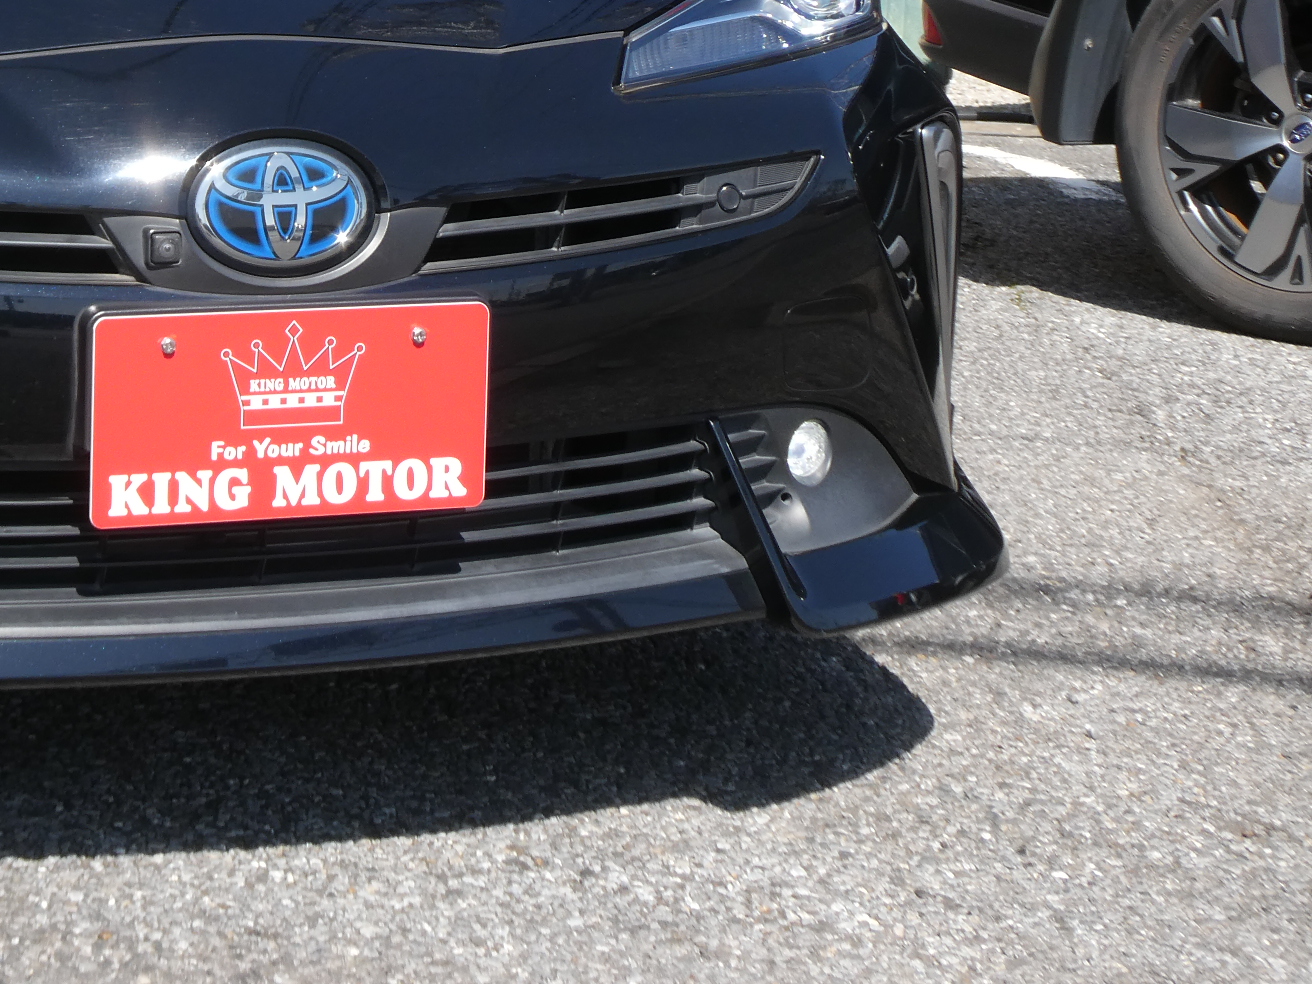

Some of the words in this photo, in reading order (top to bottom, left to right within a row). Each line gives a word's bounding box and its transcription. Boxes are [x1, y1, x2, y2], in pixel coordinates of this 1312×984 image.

[249, 377, 285, 393] KING
[288, 375, 336, 391] MOTOR
[211, 440, 246, 461] For
[253, 437, 303, 459] Your
[309, 434, 371, 455] Smile
[108, 467, 251, 517] KING
[272, 456, 467, 508] MOTOR
